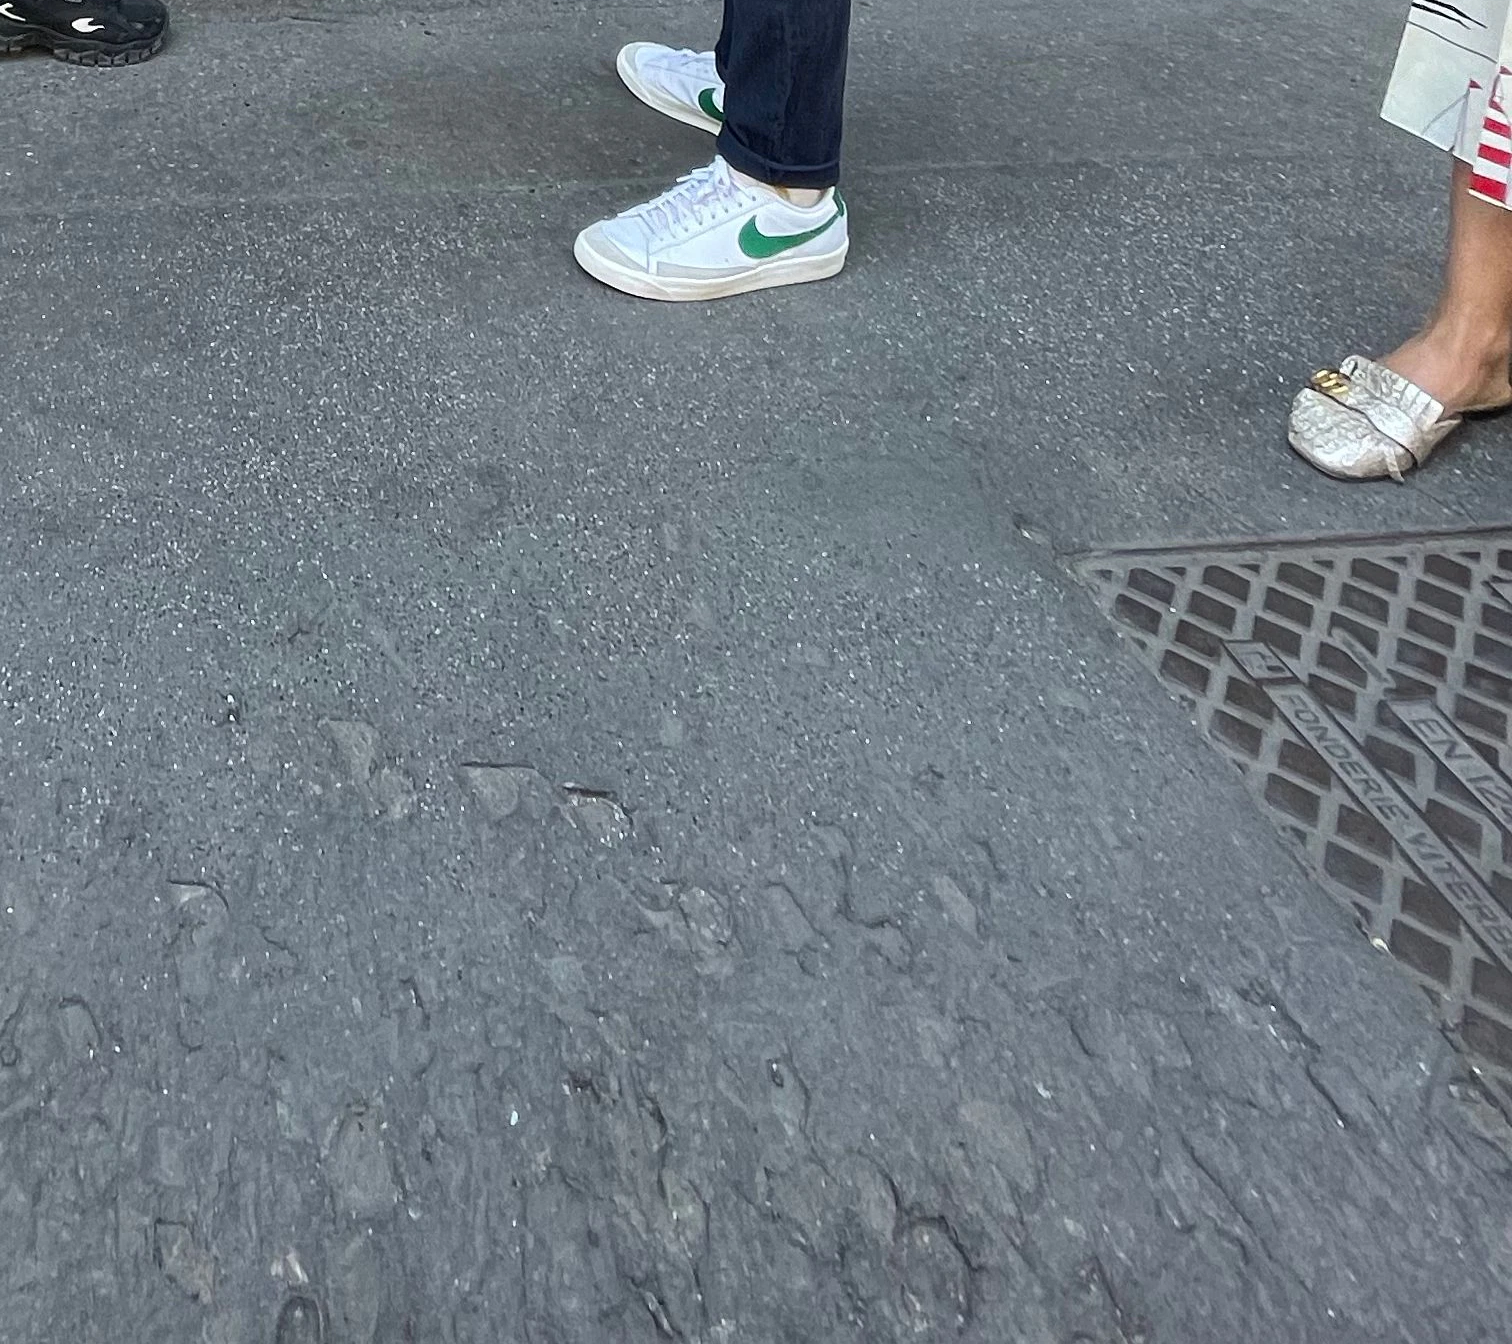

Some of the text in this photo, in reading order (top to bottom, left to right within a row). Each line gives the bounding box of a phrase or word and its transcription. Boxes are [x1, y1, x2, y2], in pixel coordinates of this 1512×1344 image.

[1409, 717, 1474, 761] EN
[1280, 691, 1512, 953] FONDERIE VITERB
